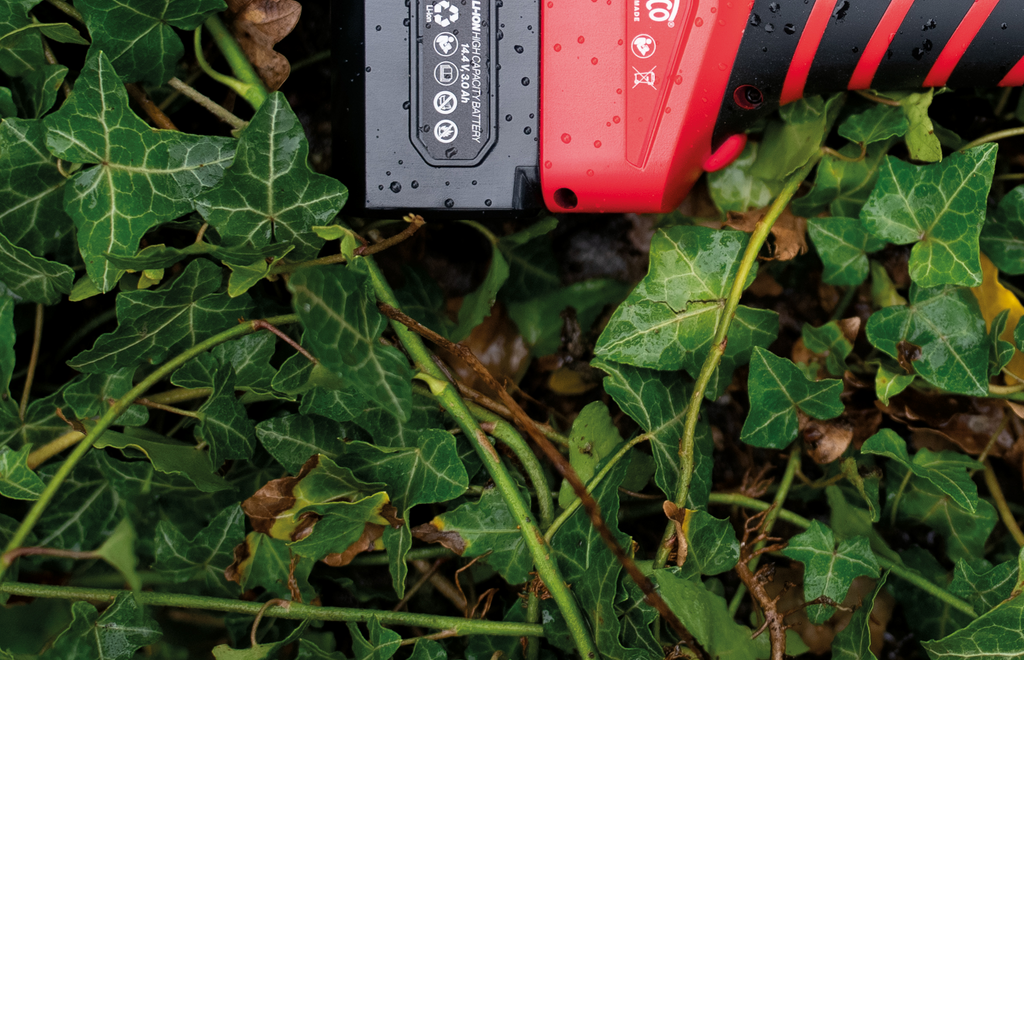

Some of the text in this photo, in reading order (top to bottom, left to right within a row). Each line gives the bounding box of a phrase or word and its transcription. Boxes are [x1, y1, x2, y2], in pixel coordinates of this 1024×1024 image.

[461, 43, 470, 62] 14.4
[471, 0, 482, 143] LI-ION HIGH CAPACITY BATTERY
[461, 74, 470, 89] 3.0
[461, 89, 470, 104] Ah
